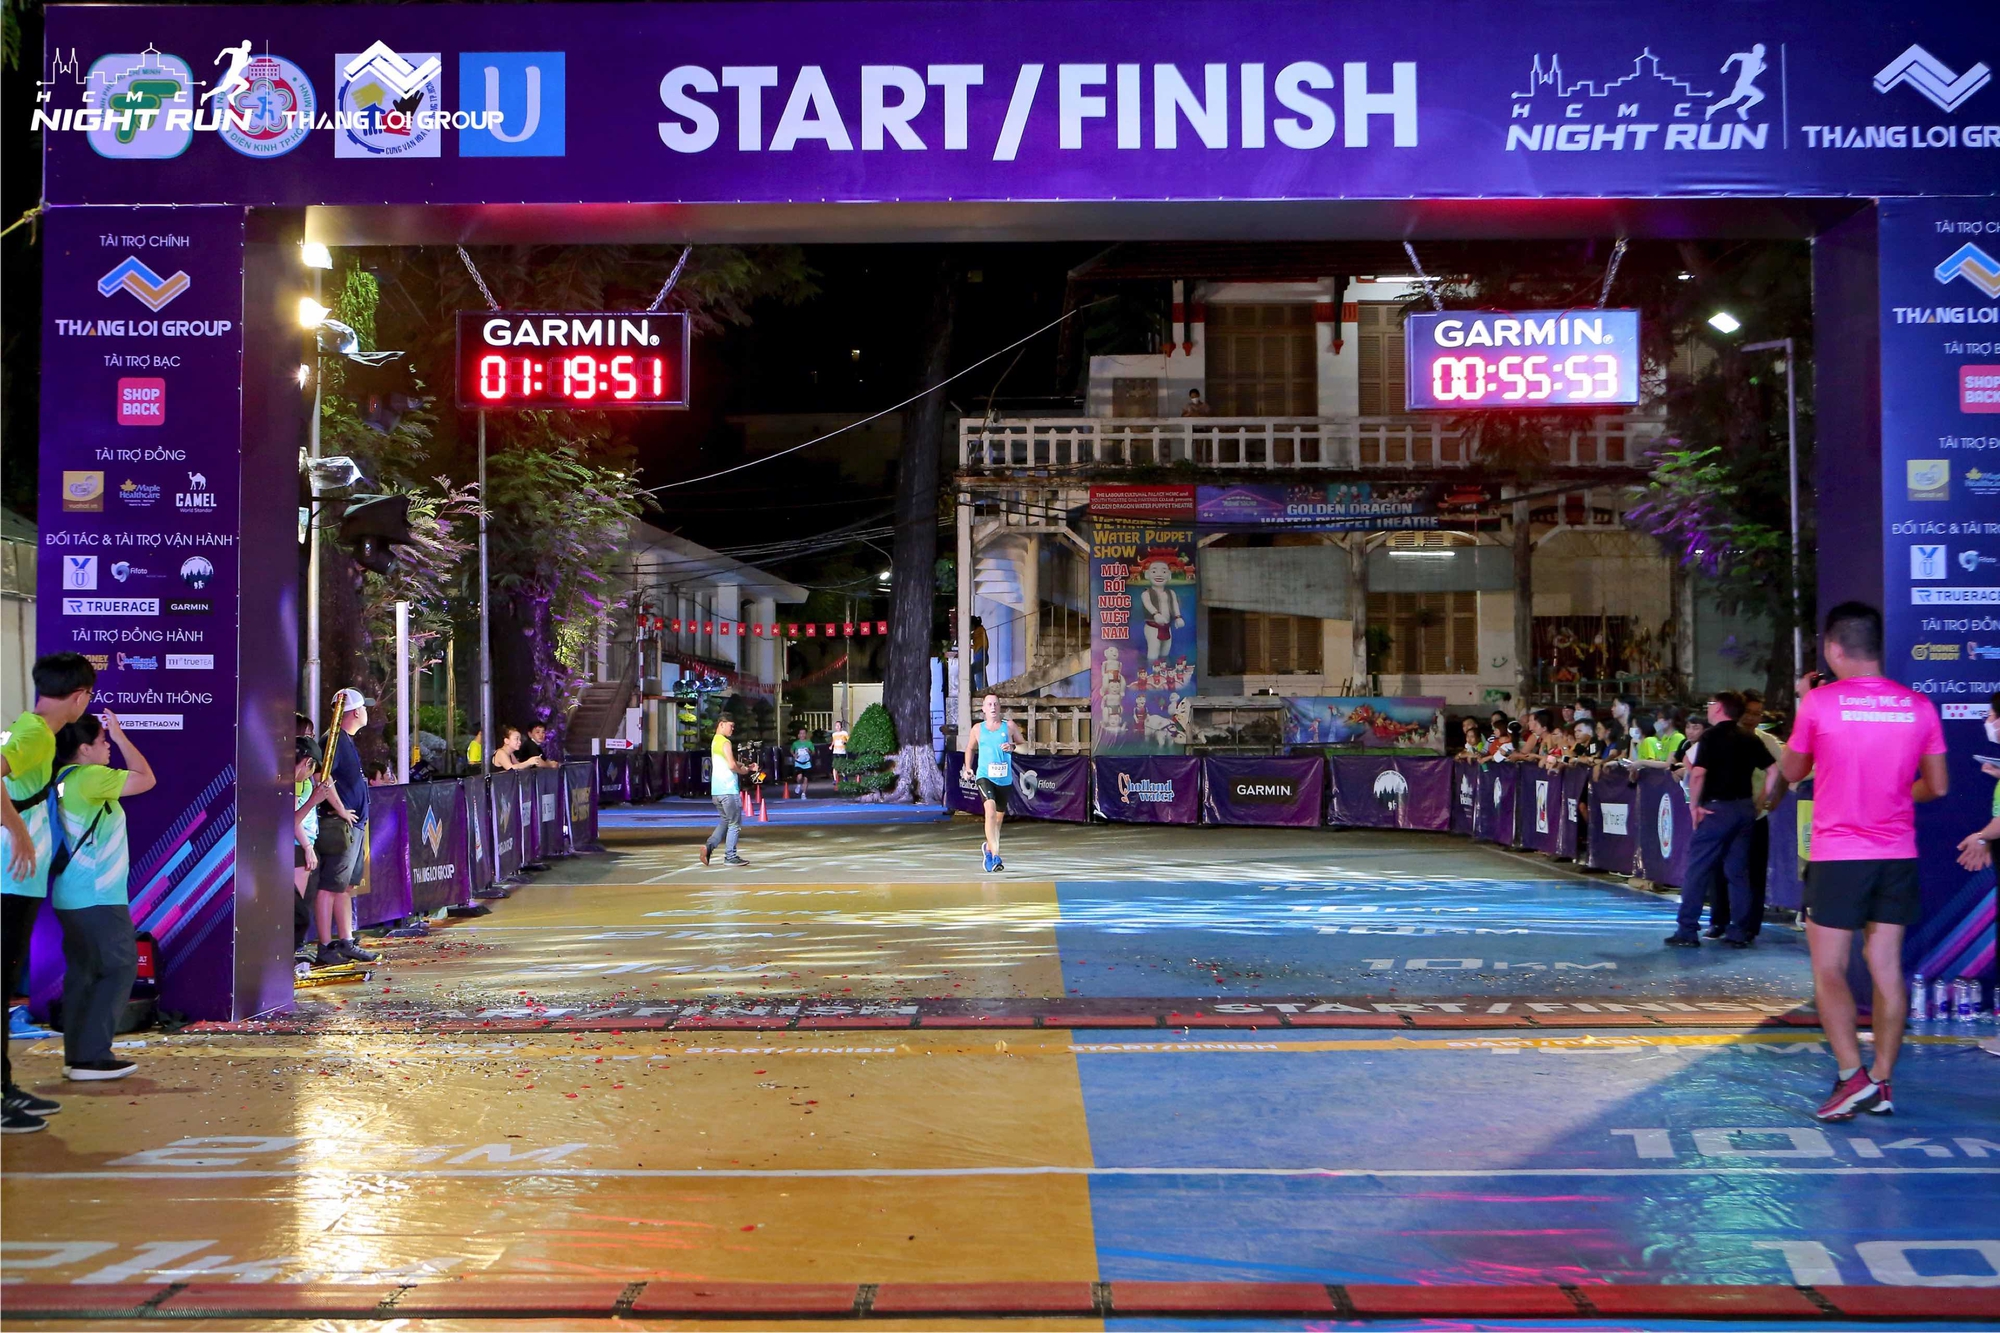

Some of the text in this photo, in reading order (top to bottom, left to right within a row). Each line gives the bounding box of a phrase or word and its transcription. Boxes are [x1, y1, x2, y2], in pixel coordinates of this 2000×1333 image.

[1505, 123, 1769, 151] NIGHT RUN
[1802, 125, 1907, 148] THANG
[1912, 126, 1956, 148] LOI
[253, 143, 278, 152] KINH
[1935, 220, 1954, 233] TÀI
[1956, 220, 1983, 235] TRỢ
[100, 233, 190, 250] TÀI TRỢ CHÍNH
[1892, 307, 1999, 324] THANG LOI
[55, 320, 232, 336] THANG LOI GROUP
[1943, 341, 1964, 354] TÀI
[1965, 342, 1991, 356] TRỢ
[104, 353, 181, 369] TÀI TRỢ BẠC
[1965, 375, 2000, 389] SHOP
[123, 388, 160, 401] SHOP
[123, 403, 160, 415] BACK
[1939, 435, 1959, 449] TÀI
[1960, 436, 1987, 451] TRỢ
[95, 447, 114, 460] TÀI
[116, 448, 142, 463] TRỢ
[175, 493, 217, 507] CAMEL
[1287, 503, 1413, 516] GOLDEN DRAGON
[1376, 516, 1439, 528] THEATRE
[1892, 520, 1917, 534] ĐỐI
[1920, 521, 1946, 534] TÁC
[1949, 523, 1960, 534] &
[1962, 521, 1981, 534] TÀI
[46, 531, 233, 548] ĐỐI TÁC & TÀI TRỢ VẬN HÀNH
[1093, 545, 1137, 559] SHOW
[130, 567, 148, 575] Fifoto
[87, 601, 156, 613] TRUERACE
[170, 603, 209, 611] GARMIN
[1921, 617, 1941, 631] TÀI
[1943, 618, 1969, 633] TRỢ
[72, 627, 91, 641] TÀI
[93, 628, 119, 644] TRỢ
[166, 627, 203, 642] HÀNH
[1101, 627, 1130, 640] NAM
[83, 654, 109, 663] ONEY
[1912, 679, 1937, 693] ĐỐI
[1939, 680, 1966, 693] TÁC
[117, 689, 163, 703] TRUYỀN
[166, 690, 213, 704] THÔNG
[1841, 710, 1916, 723] RUNNERS
[1038, 780, 1056, 790] Fifoto
[1127, 779, 1173, 792] holland
[1236, 784, 1292, 797] GARMIN
[1313, 925, 1530, 935] 10KM
[1361, 957, 1618, 971] 10KM
